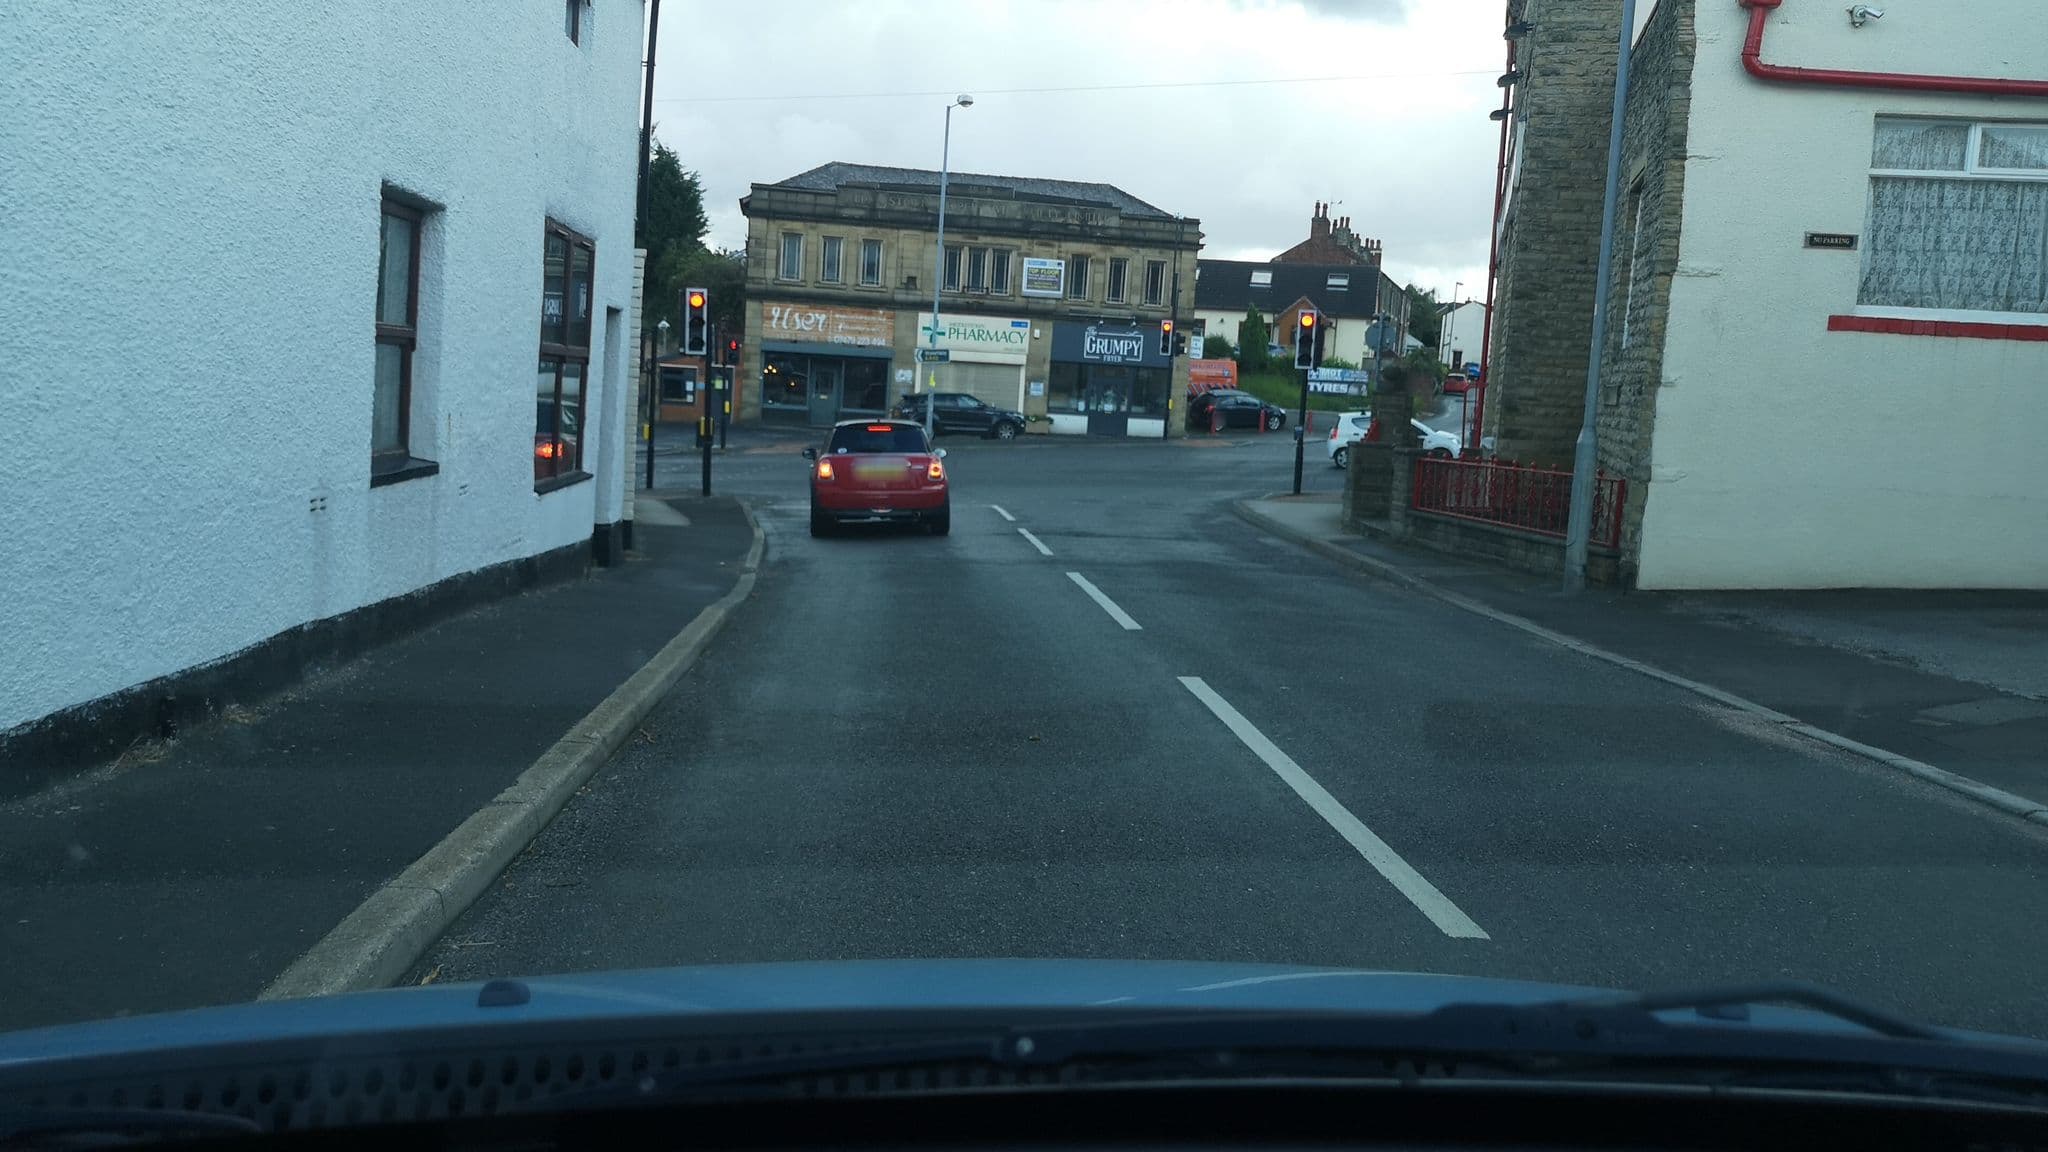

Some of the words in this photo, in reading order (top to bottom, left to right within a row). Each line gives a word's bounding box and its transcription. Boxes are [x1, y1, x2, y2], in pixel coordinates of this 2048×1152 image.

[948, 328, 1027, 344] PHARMACY
[1086, 336, 1140, 357] GRUMPY
[1102, 354, 1123, 363] FRYER
[1321, 367, 1343, 378] MOT
[1308, 381, 1349, 394] TYRES
